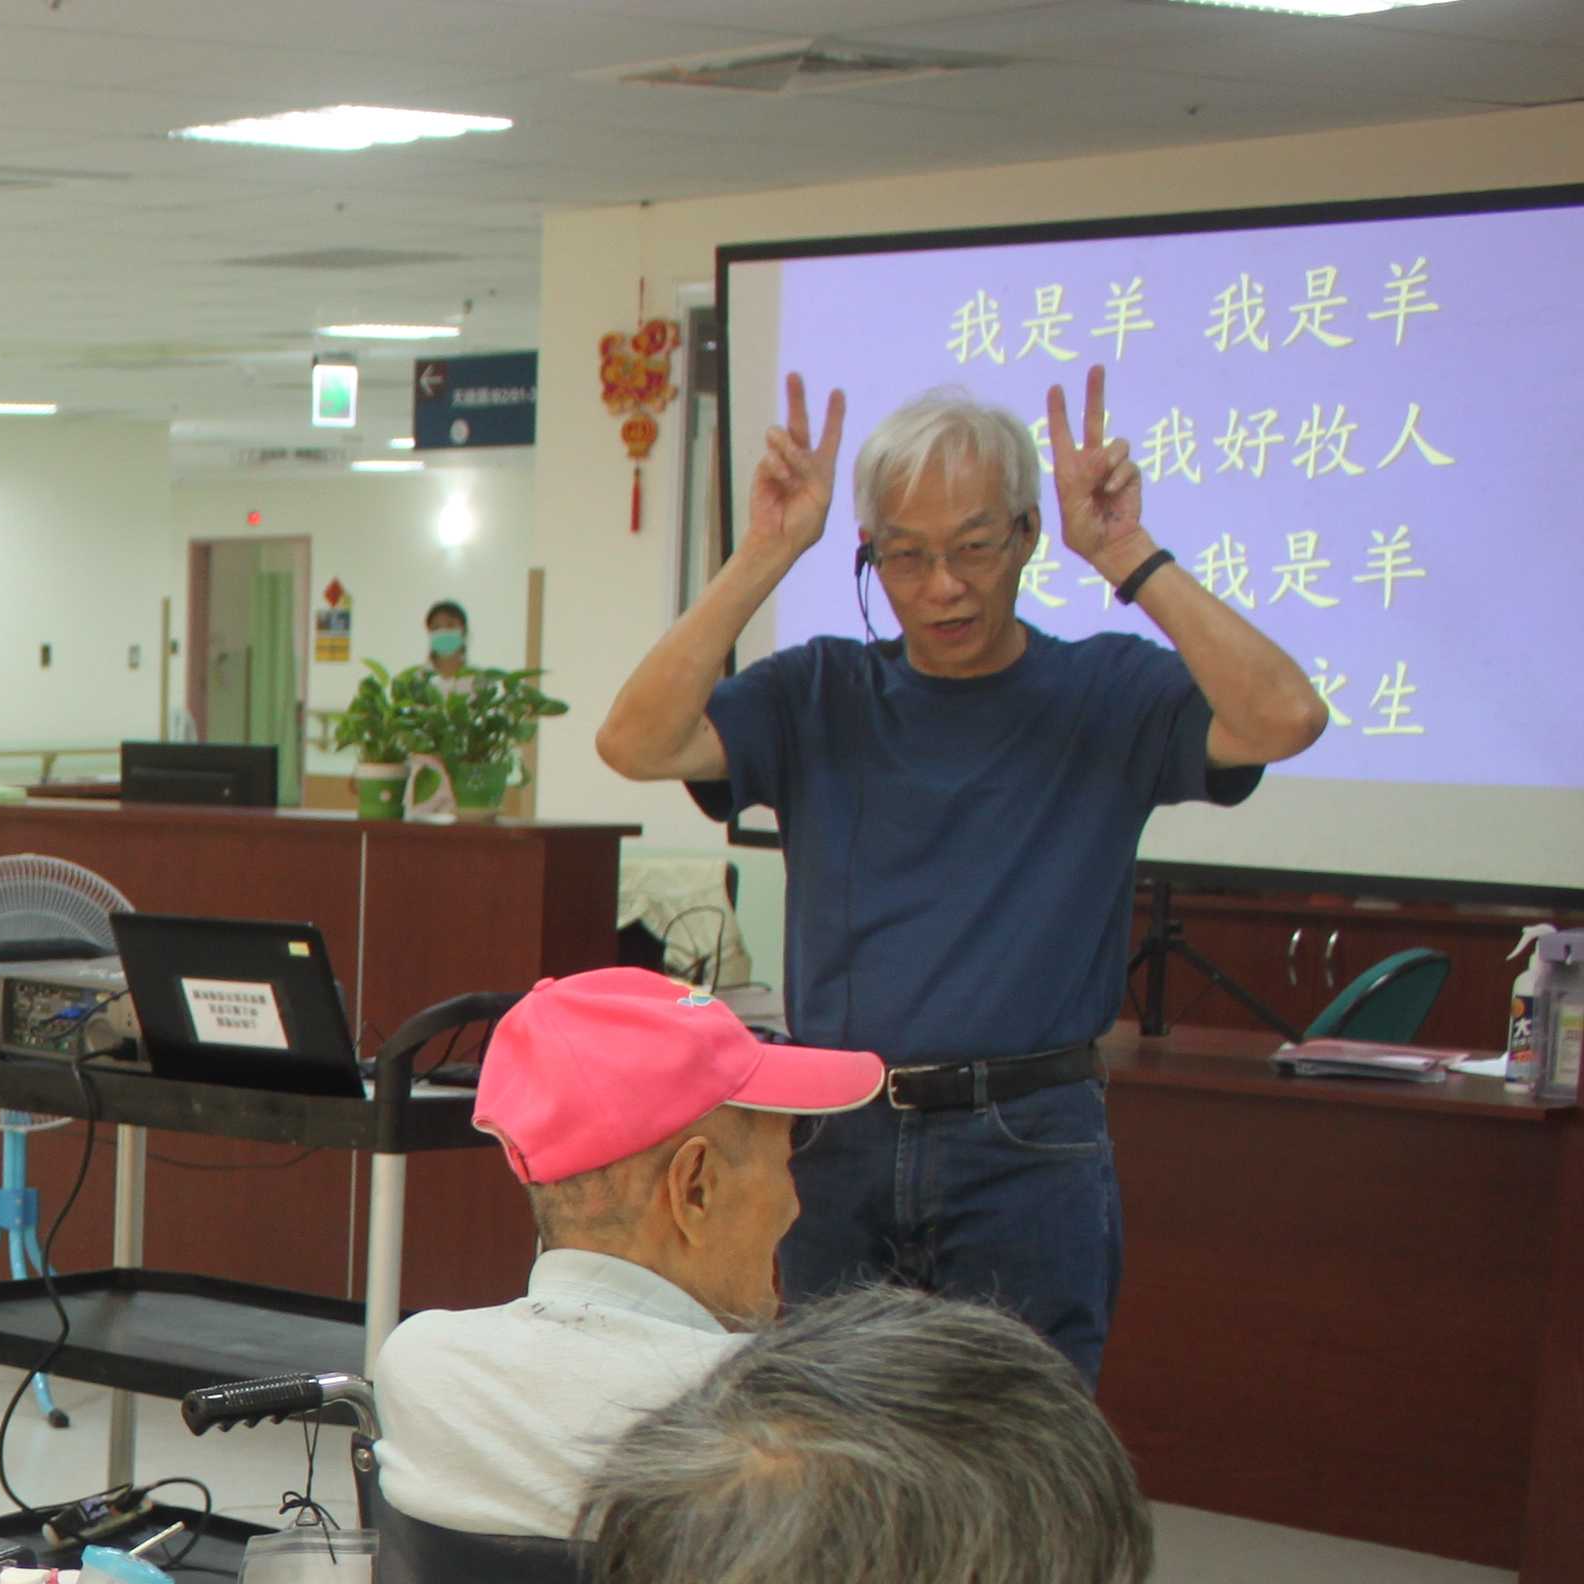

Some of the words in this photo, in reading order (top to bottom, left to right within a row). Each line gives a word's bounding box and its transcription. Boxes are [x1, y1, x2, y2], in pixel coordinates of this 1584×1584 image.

[946, 275, 1155, 365] 我是羊
[1203, 256, 1440, 353] 我是羊
[1193, 523, 1427, 609] 我是羊
